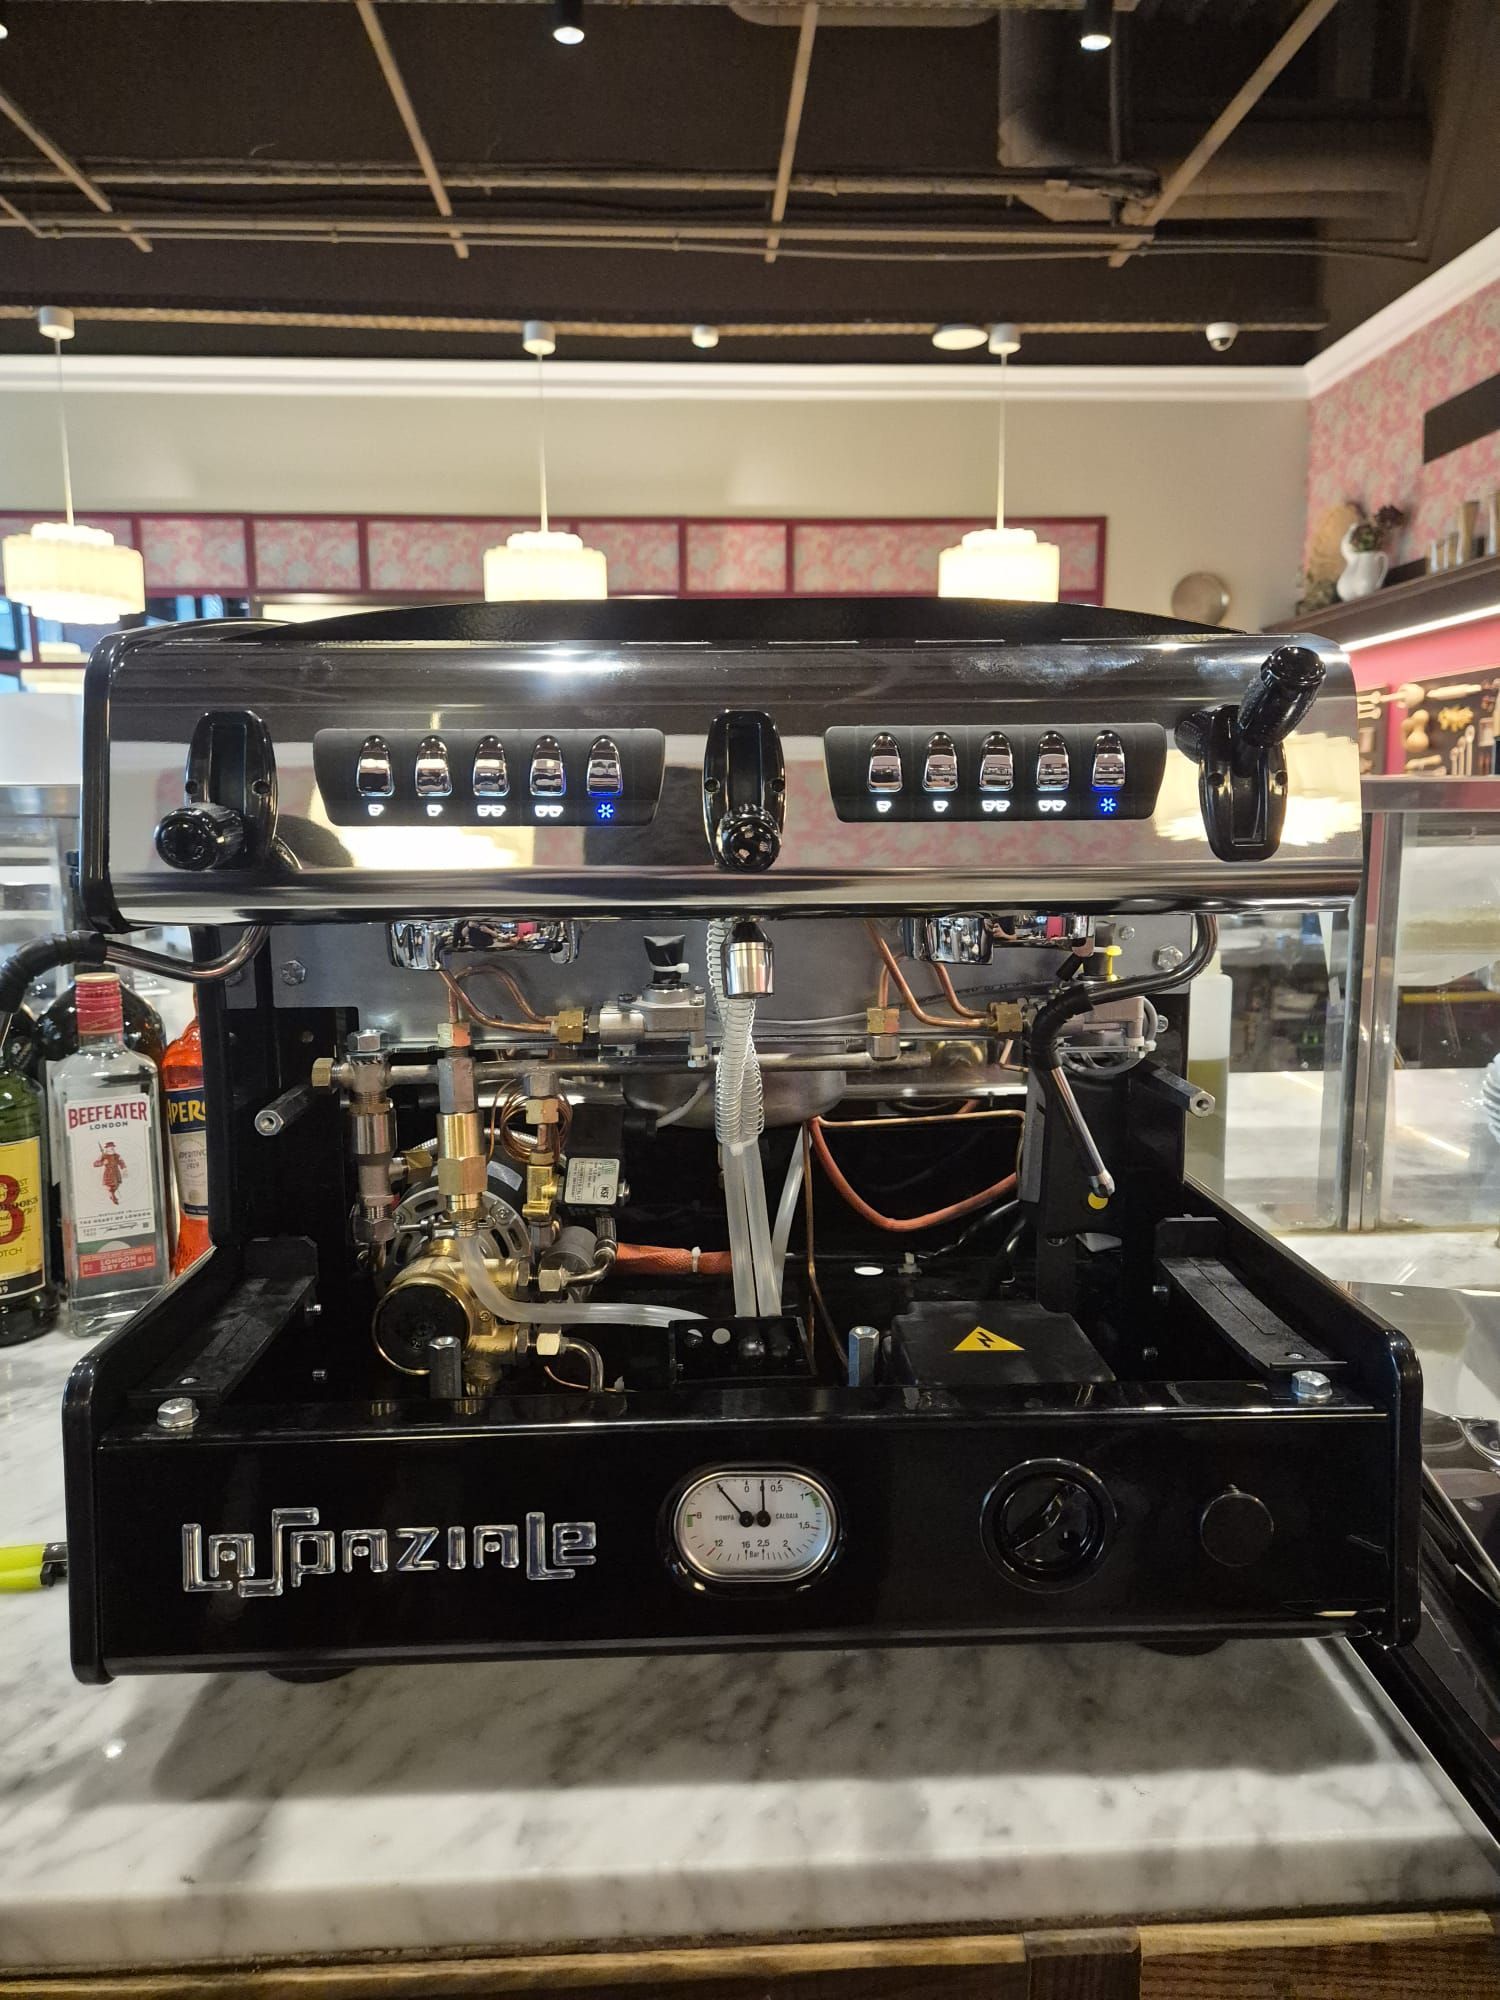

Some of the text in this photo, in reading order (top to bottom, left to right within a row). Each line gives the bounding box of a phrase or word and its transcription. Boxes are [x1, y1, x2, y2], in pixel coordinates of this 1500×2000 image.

[68, 1102, 148, 1129] BEEFEATER
[90, 1121, 128, 1130] LONDON
[601, 1187, 609, 1199] NSF
[100, 1255, 137, 1265] LONDON
[100, 1263, 119, 1271] DRY
[770, 1485, 783, 1494] 0,5
[799, 1522, 810, 1530] 1,5
